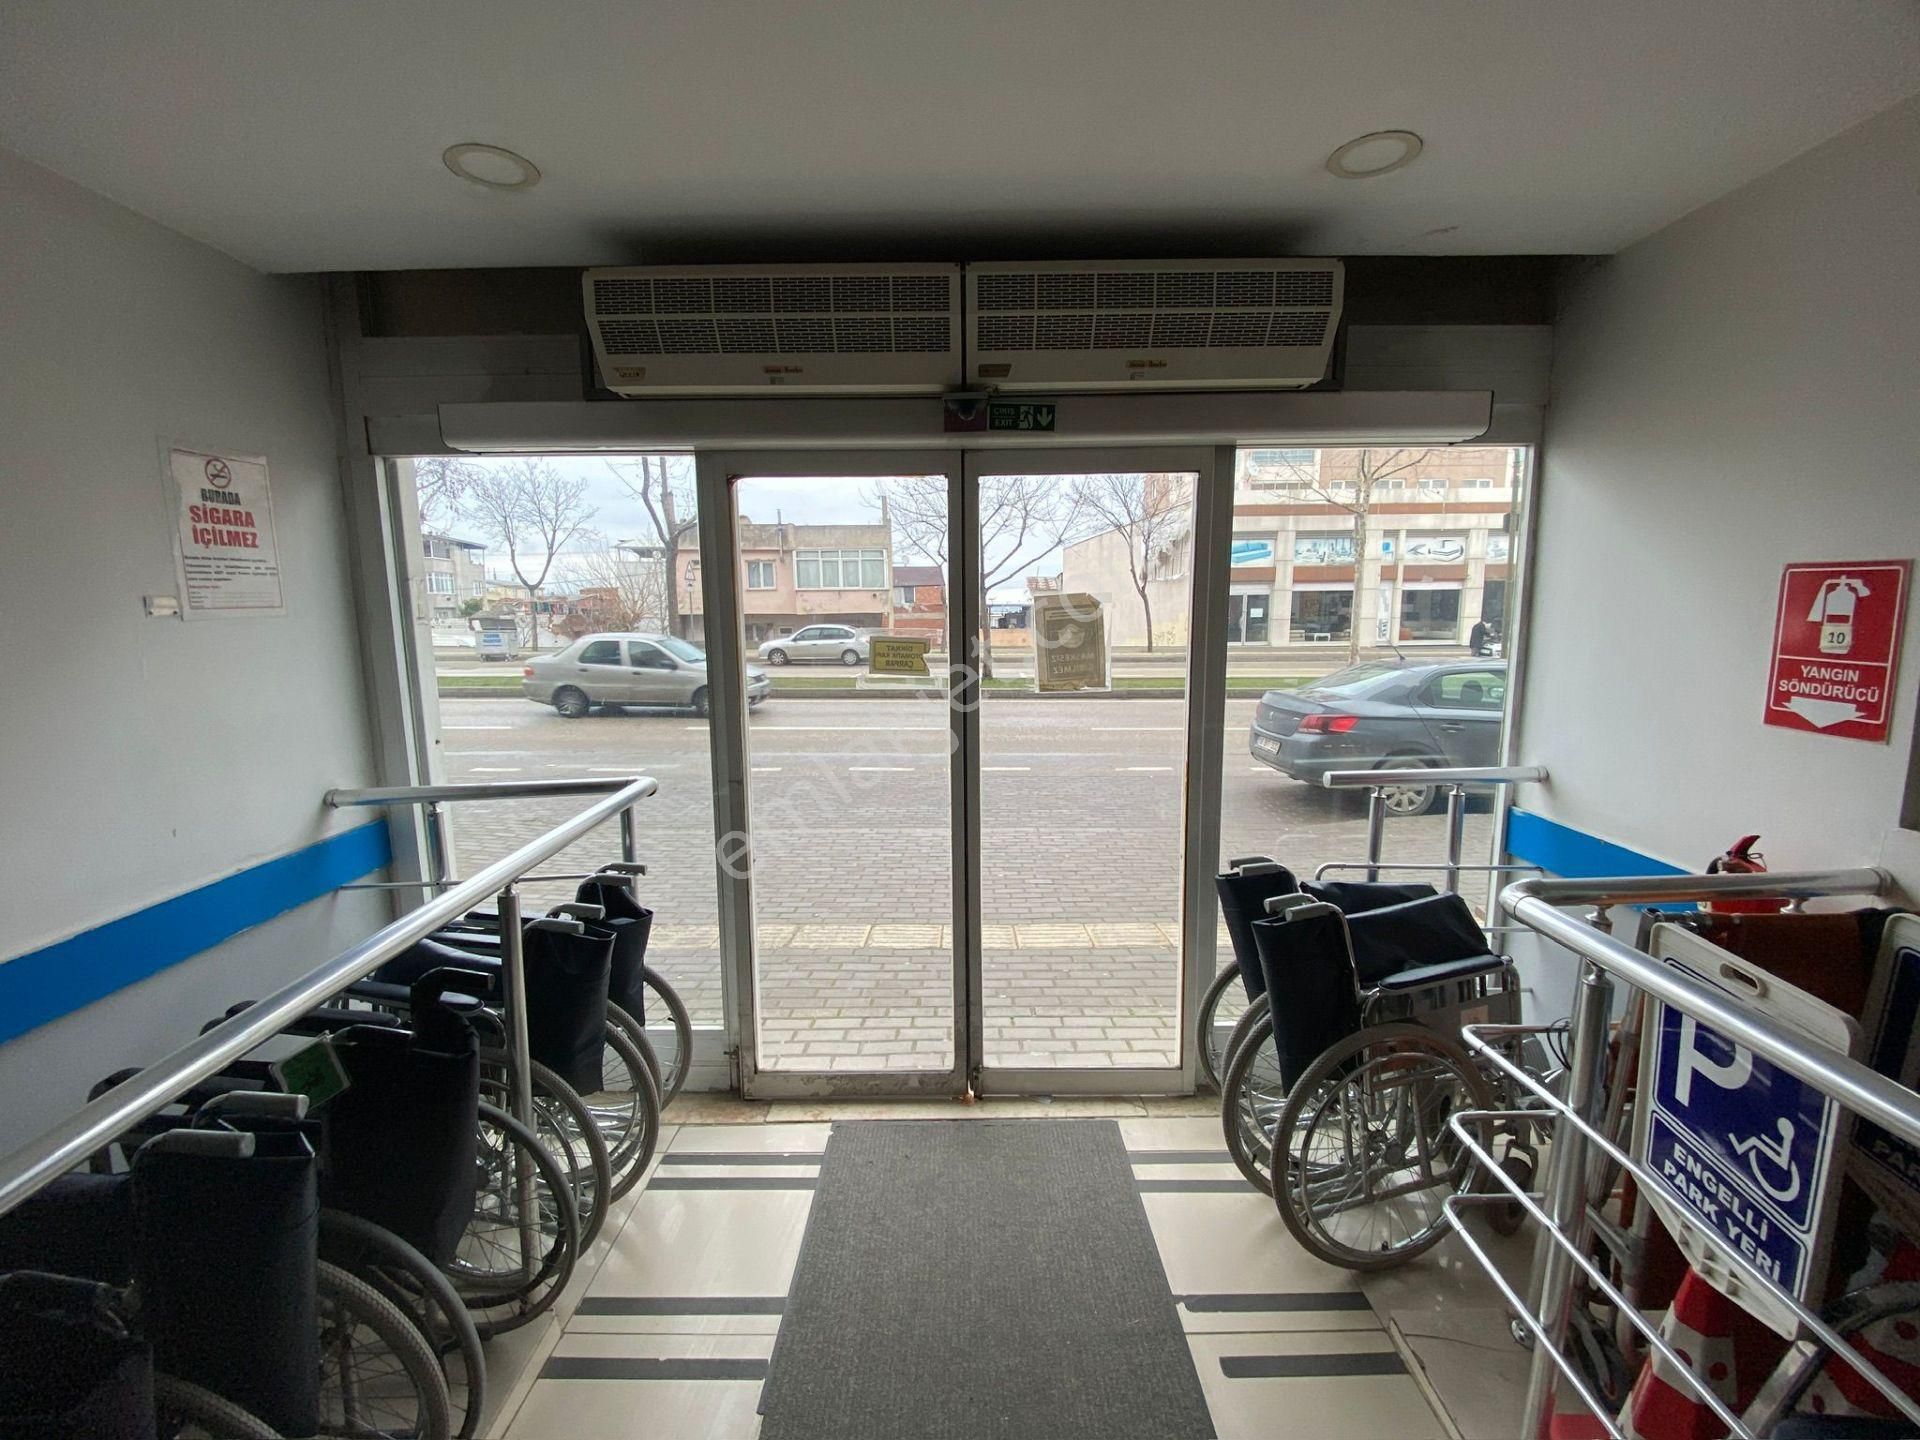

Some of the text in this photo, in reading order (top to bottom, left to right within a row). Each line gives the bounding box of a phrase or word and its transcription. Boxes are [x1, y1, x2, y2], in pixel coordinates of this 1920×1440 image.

[994, 418, 1013, 427] EXIT
[200, 488, 242, 505] BURADA
[189, 503, 256, 528] SİGARA
[192, 524, 259, 549] İÇİLMEZ
[1827, 631, 1846, 645] 10
[1801, 664, 1860, 682] YANGIN
[1778, 678, 1880, 703] SÖNDÜRÜCÜ
[1675, 1012, 1753, 1108] P
[1673, 1142, 1769, 1242] ENGELLİ
[1664, 1158, 1781, 1283] PARK YERİ
